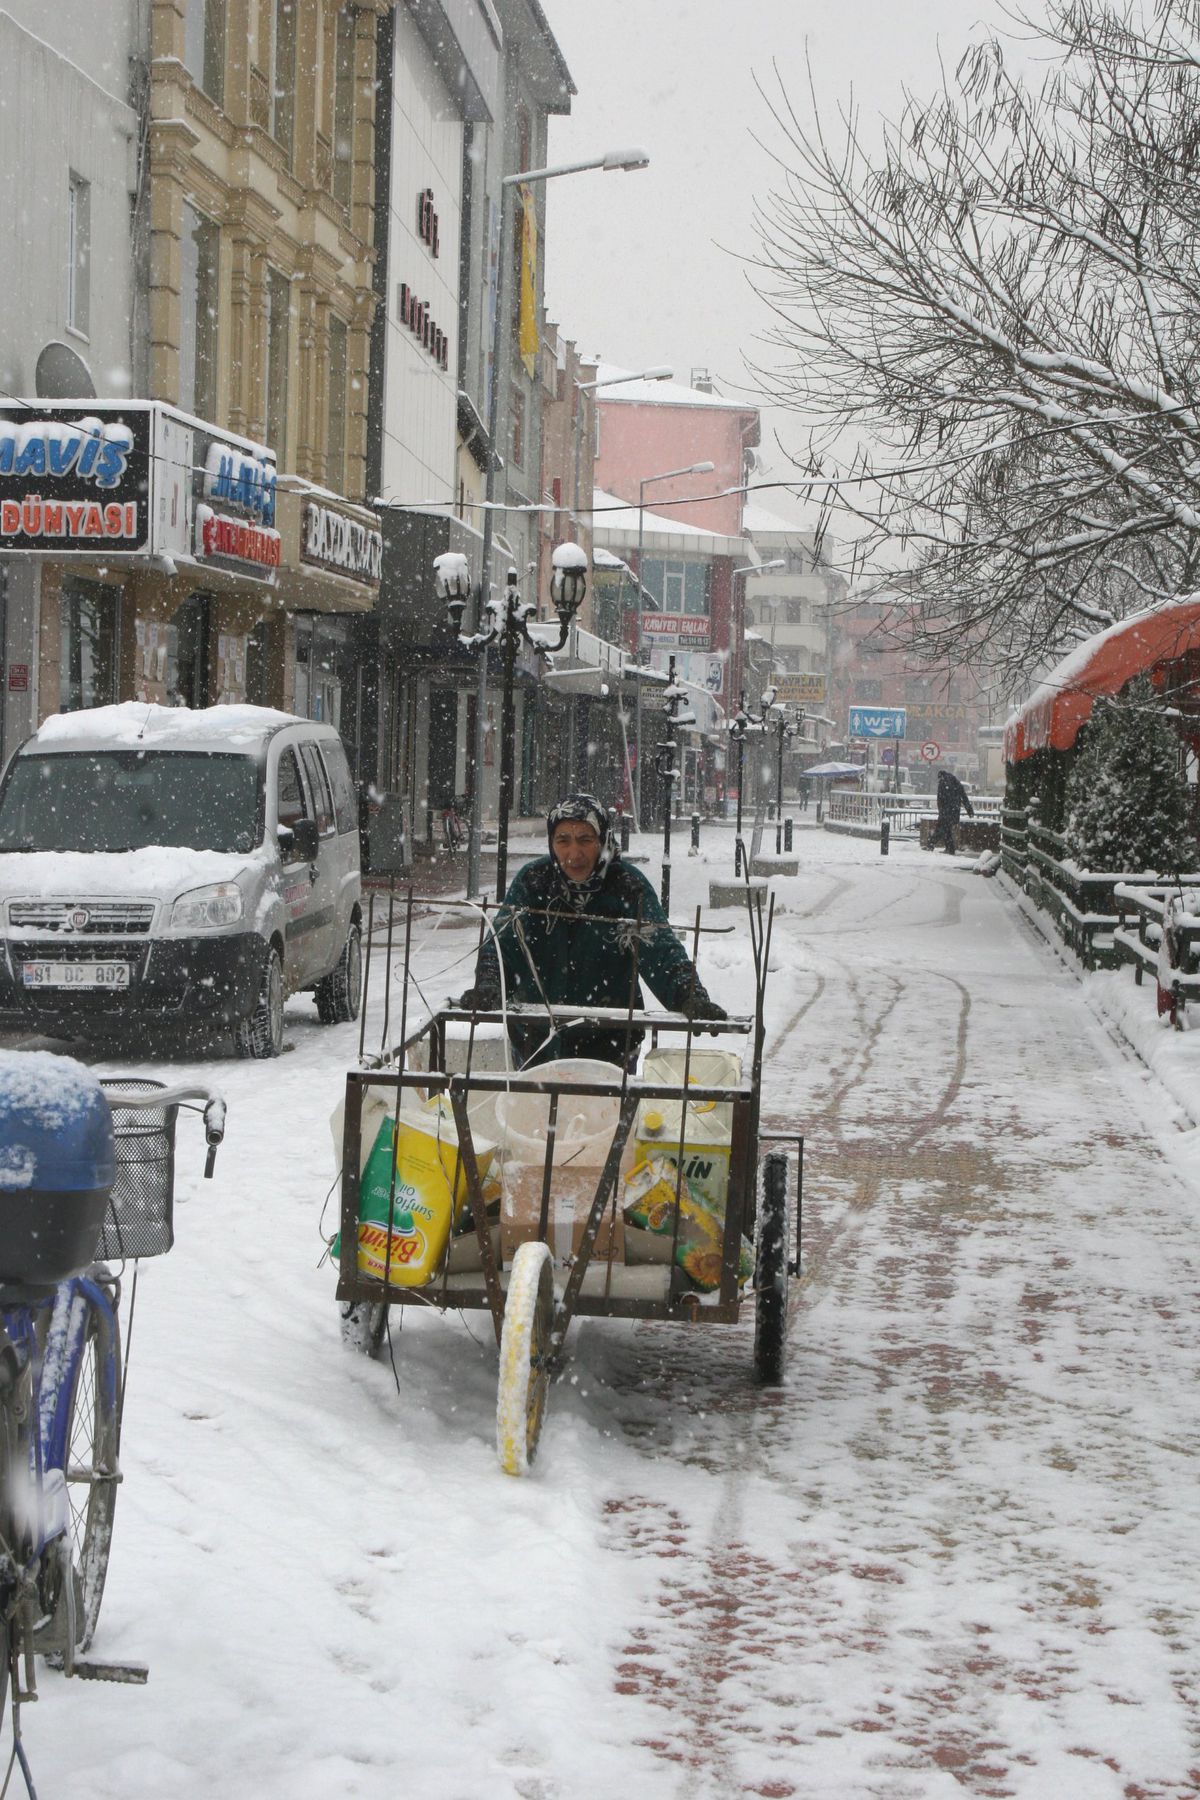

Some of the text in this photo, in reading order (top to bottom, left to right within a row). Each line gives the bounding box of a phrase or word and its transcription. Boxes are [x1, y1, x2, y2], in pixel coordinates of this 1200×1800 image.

[1, 495, 137, 538] DÜNYASI
[863, 717, 893, 728] WC
[400, 1184, 416, 1196] Oil
[359, 1224, 419, 1264] Bizim
